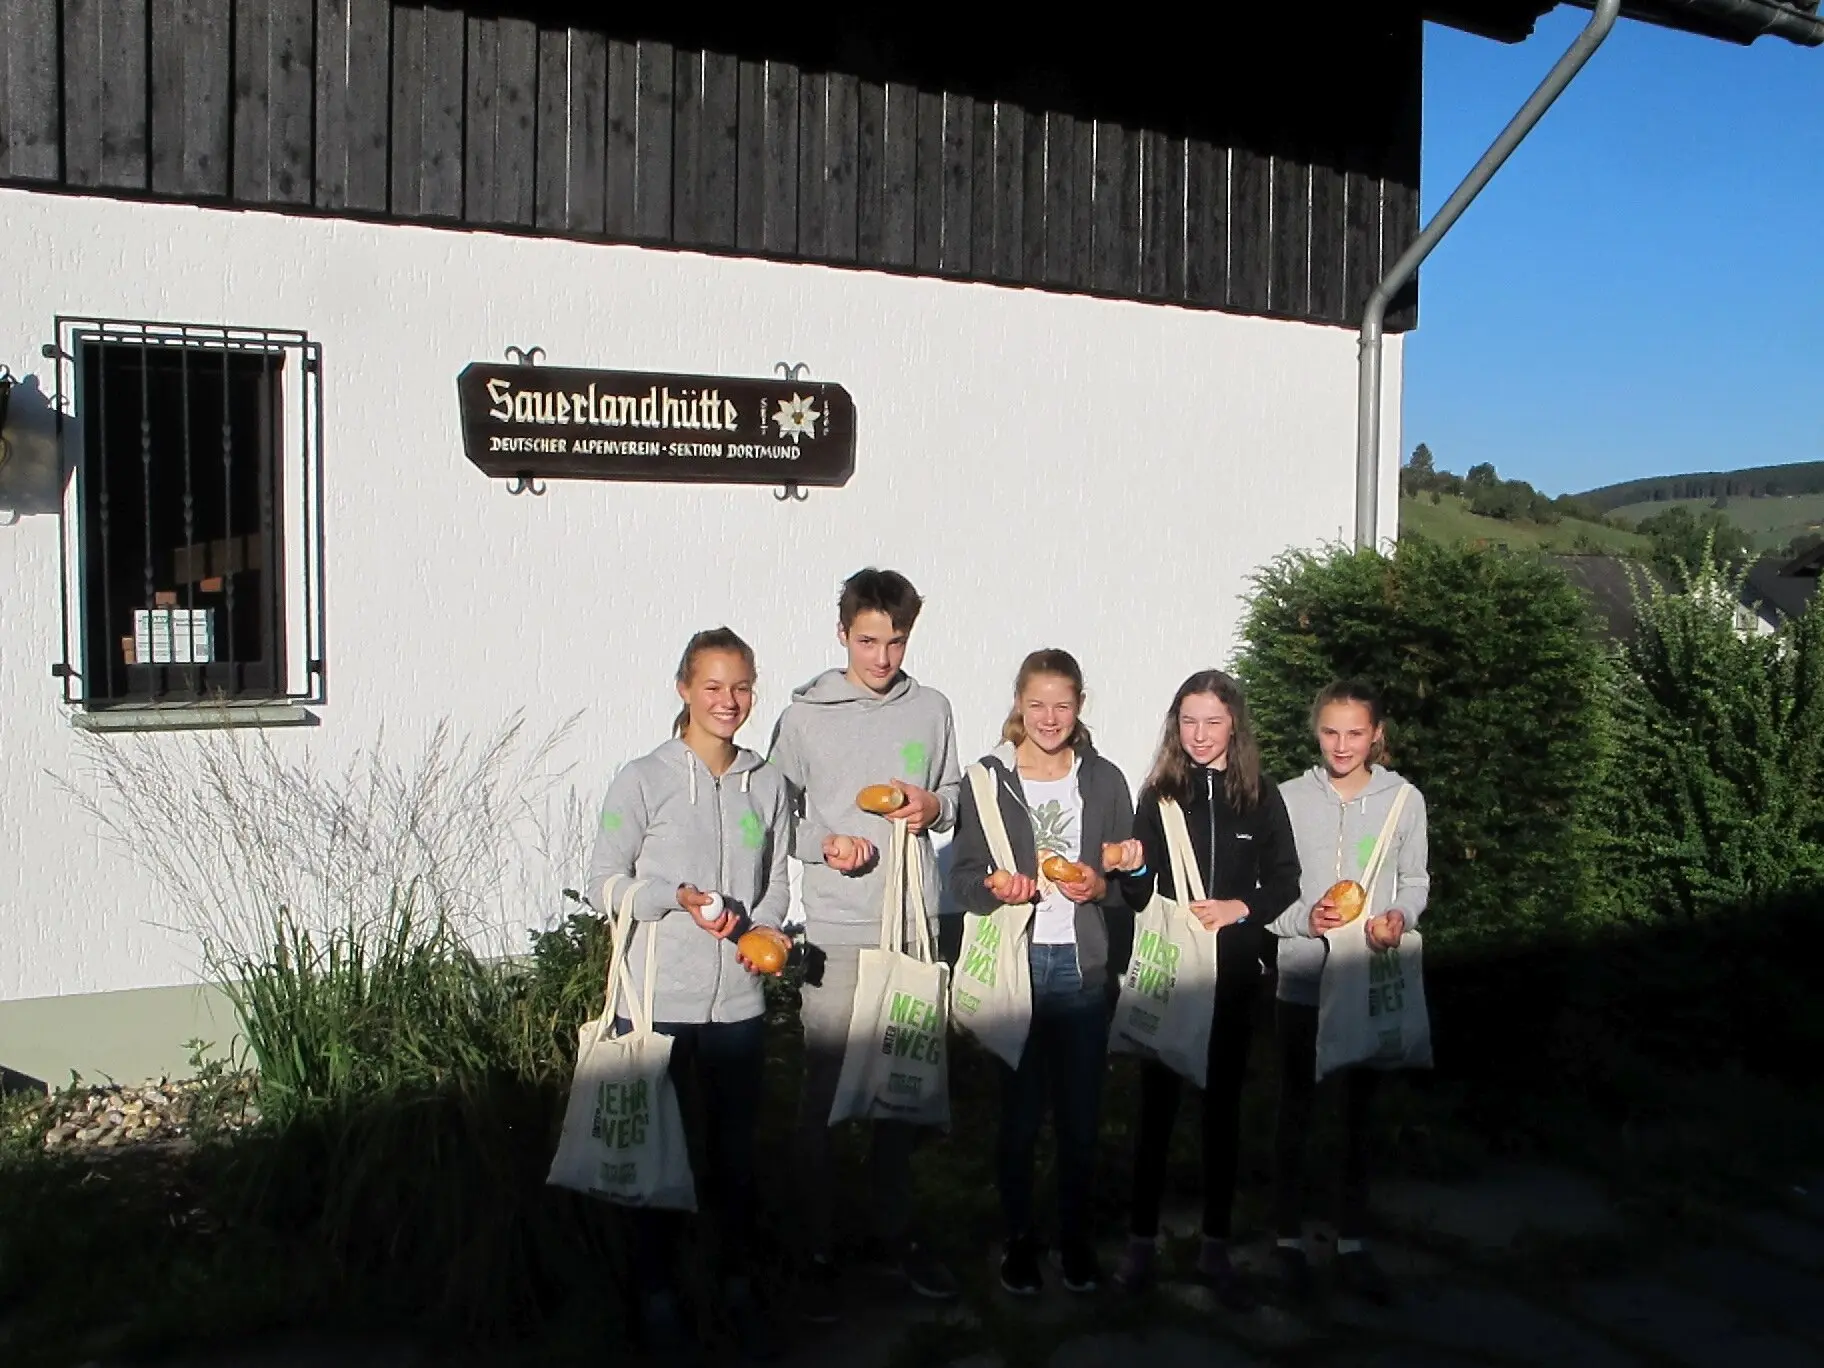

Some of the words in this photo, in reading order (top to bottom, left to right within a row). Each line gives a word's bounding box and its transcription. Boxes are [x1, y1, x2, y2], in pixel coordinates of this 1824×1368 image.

[486, 378, 739, 432] Sauerlandhütte
[489, 436, 567, 453] DEUTSCHER
[726, 444, 801, 460] DORTMUND
